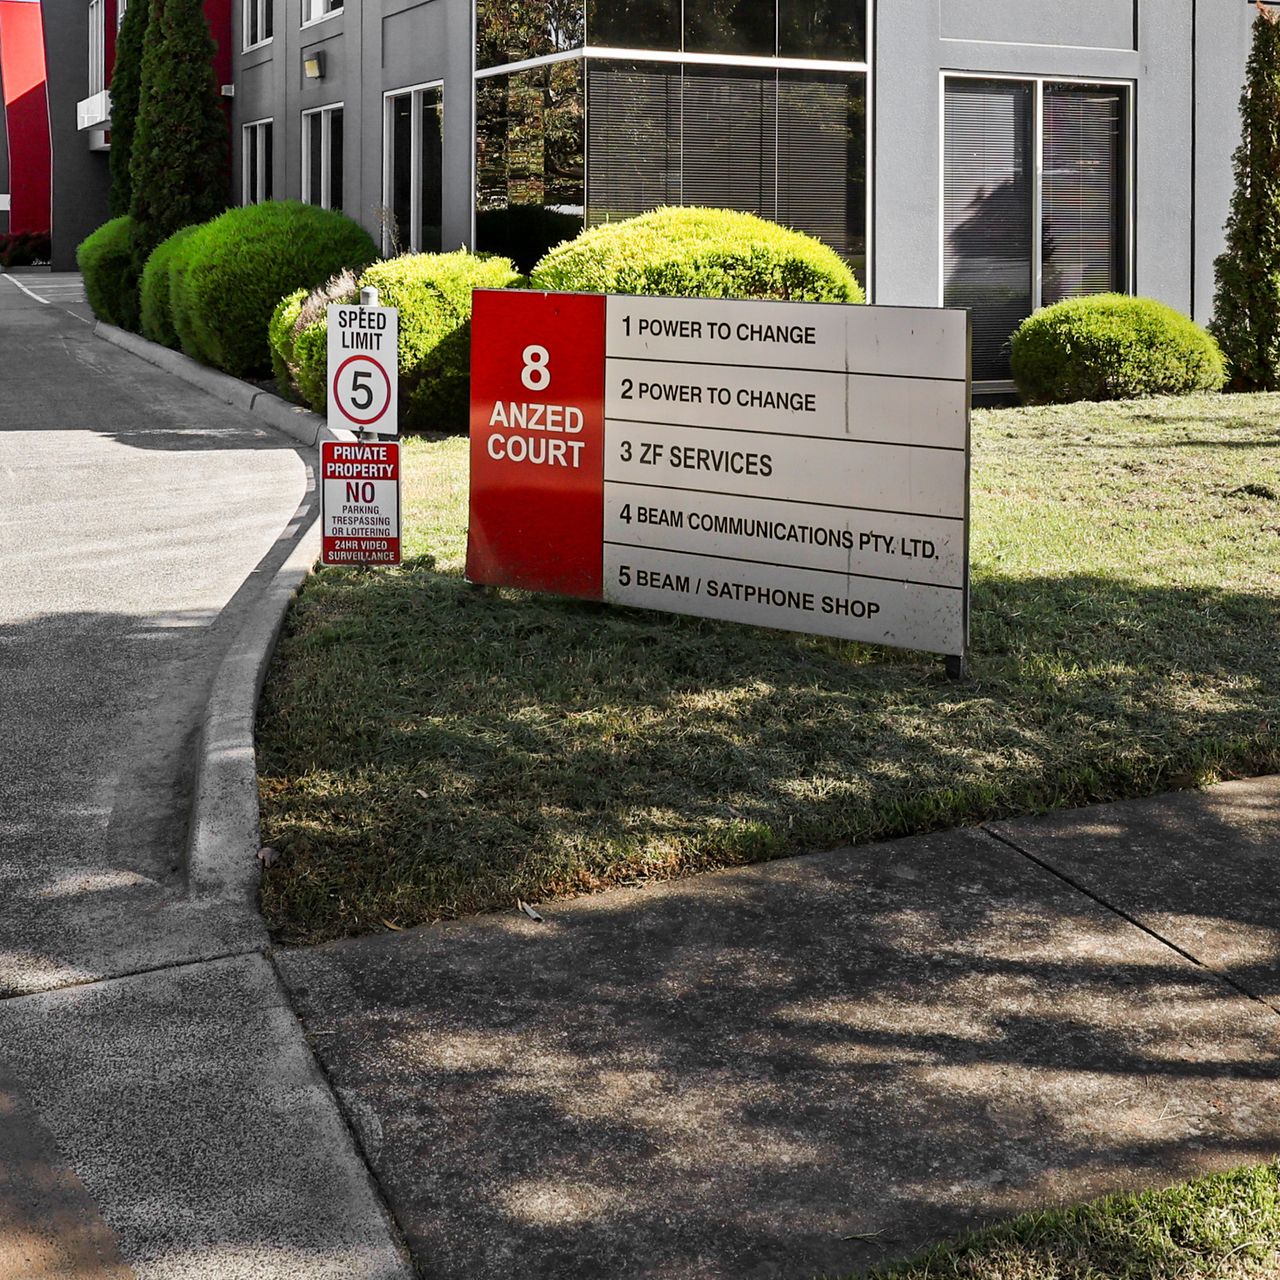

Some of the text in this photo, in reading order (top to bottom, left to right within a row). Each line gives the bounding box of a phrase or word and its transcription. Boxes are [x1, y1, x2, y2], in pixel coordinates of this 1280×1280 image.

[338, 310, 387, 330] SPEED
[622, 315, 816, 344] 1 POWER TO CHANGE
[341, 331, 383, 350] LIMIT
[520, 344, 551, 391] 8
[350, 370, 374, 410] 5
[620, 378, 816, 411] 2 POWER TO CHANGE
[488, 400, 584, 434] ANZED
[333, 445, 387, 461] PRIVATE
[487, 433, 585, 468] COURT
[620, 440, 773, 477] 3 ZF SERVICES
[326, 463, 394, 478] PROPERTY
[346, 481, 376, 503] NO
[331, 515, 391, 526] TRESPASSING
[342, 505, 380, 515] PARKING
[331, 527, 391, 537] OR LOITERING
[619, 504, 939, 560] 4 BEAM COMMUNICATIONS PTY. LTD.
[328, 551, 395, 561] SURVEILLANCE
[334, 540, 388, 550] 24HR VIDEO
[618, 565, 880, 619] 5 BEAM / SATPHONE SHOP
